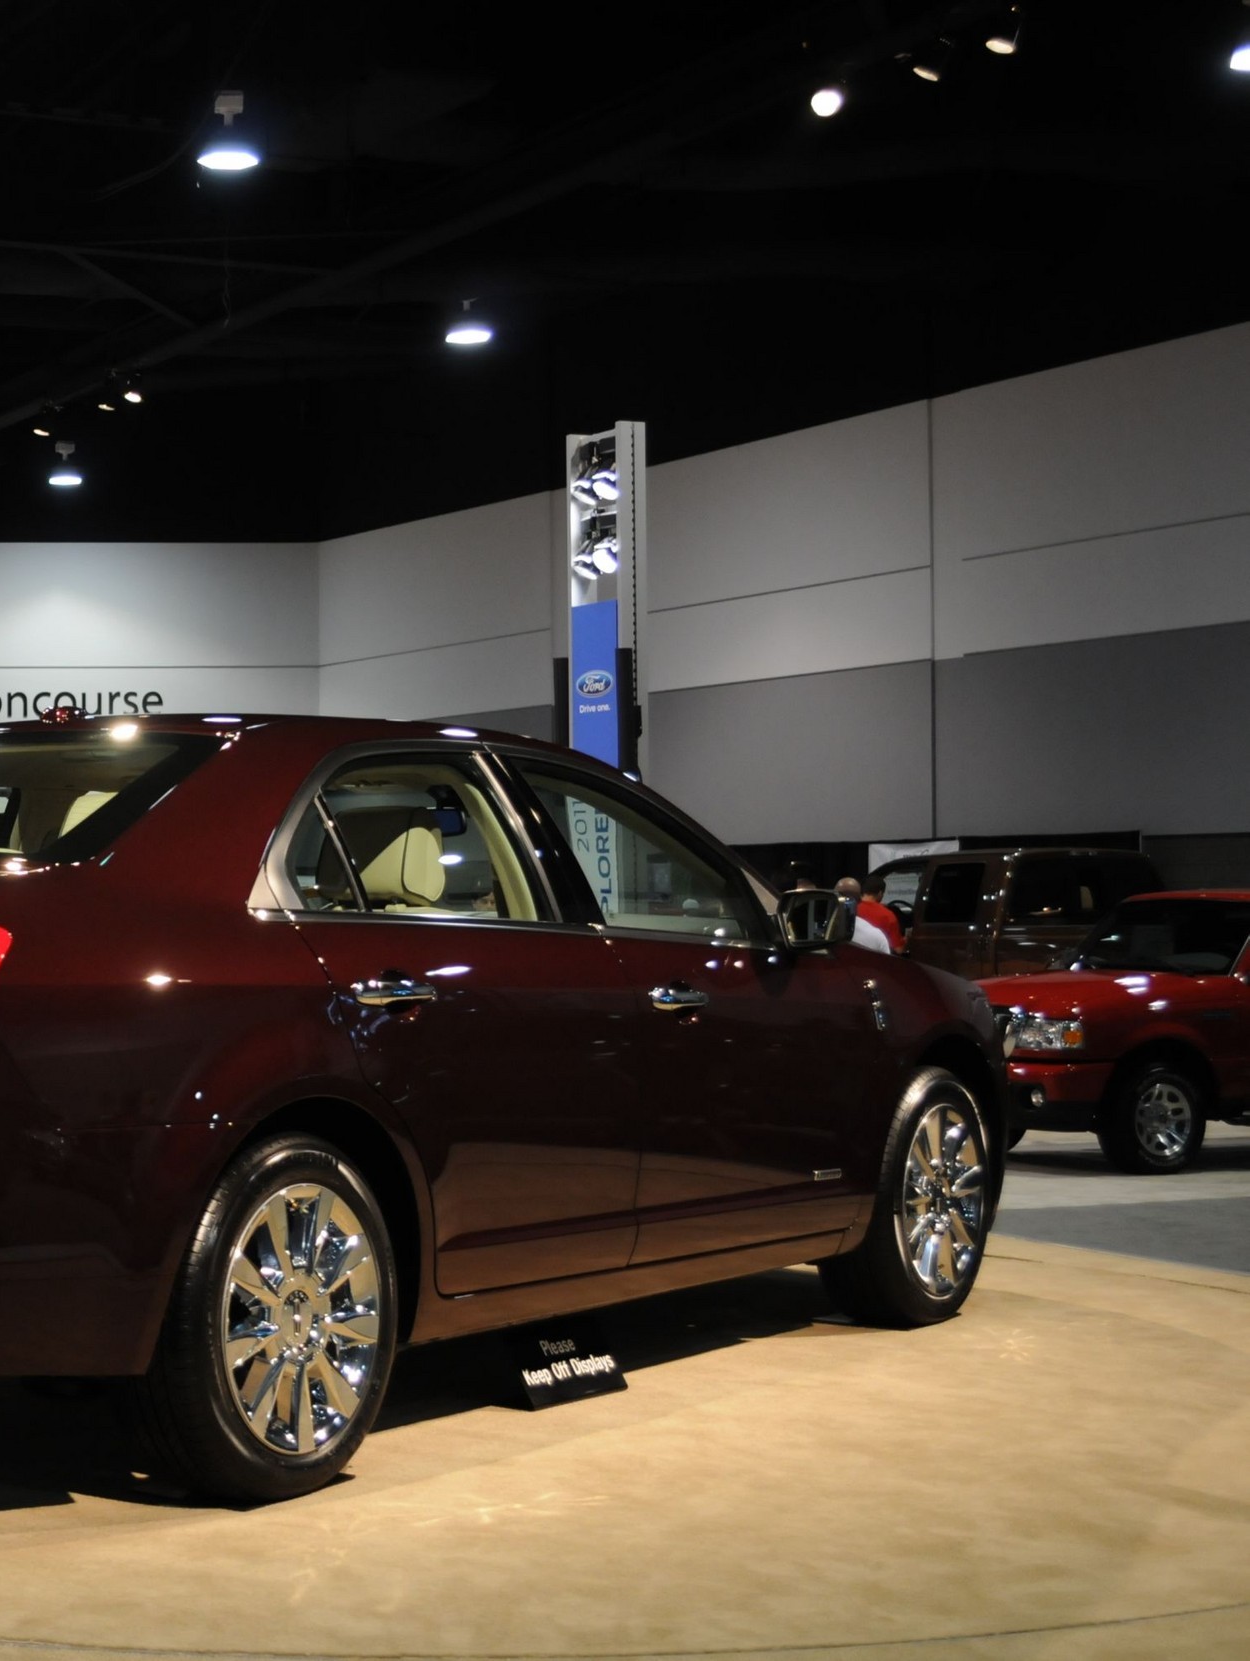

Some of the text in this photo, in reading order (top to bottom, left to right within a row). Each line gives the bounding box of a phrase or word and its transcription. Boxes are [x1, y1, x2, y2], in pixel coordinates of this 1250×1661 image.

[579, 704, 596, 714] Drive
[539, 1339, 576, 1356] Please
[522, 1354, 615, 1386] Keep Off Displays
